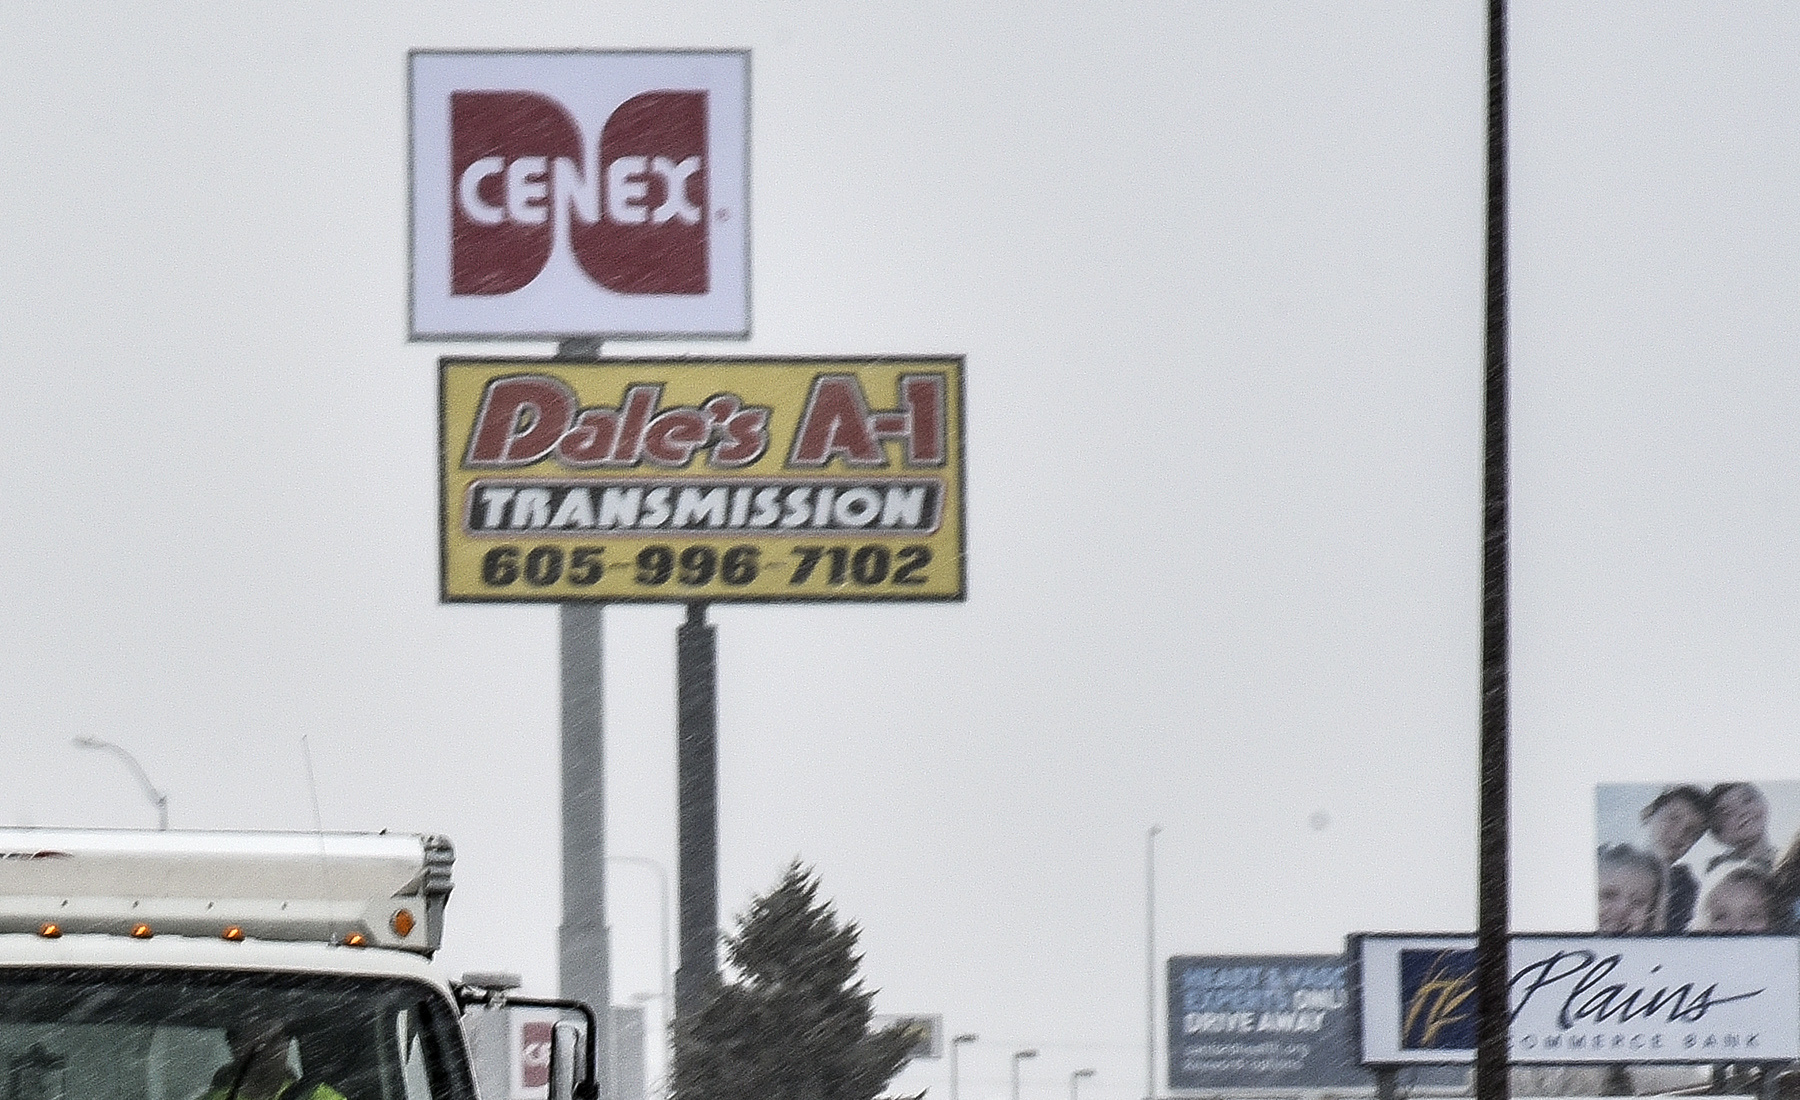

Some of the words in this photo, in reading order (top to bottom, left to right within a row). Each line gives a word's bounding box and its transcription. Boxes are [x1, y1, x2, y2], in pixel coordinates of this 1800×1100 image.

[457, 154, 702, 226] CENEX
[461, 372, 769, 468] Dale's
[786, 371, 947, 468] A-1
[481, 486, 927, 530] TRANSMISSION
[481, 544, 934, 588] 605-996-7102
[1507, 949, 1766, 1030] Plains
[1183, 1012, 1255, 1034] DRIVE
[1255, 1012, 1326, 1033] AWAY
[1508, 1033, 1663, 1051] OMMERCE
[1682, 1033, 1763, 1049] BANK
